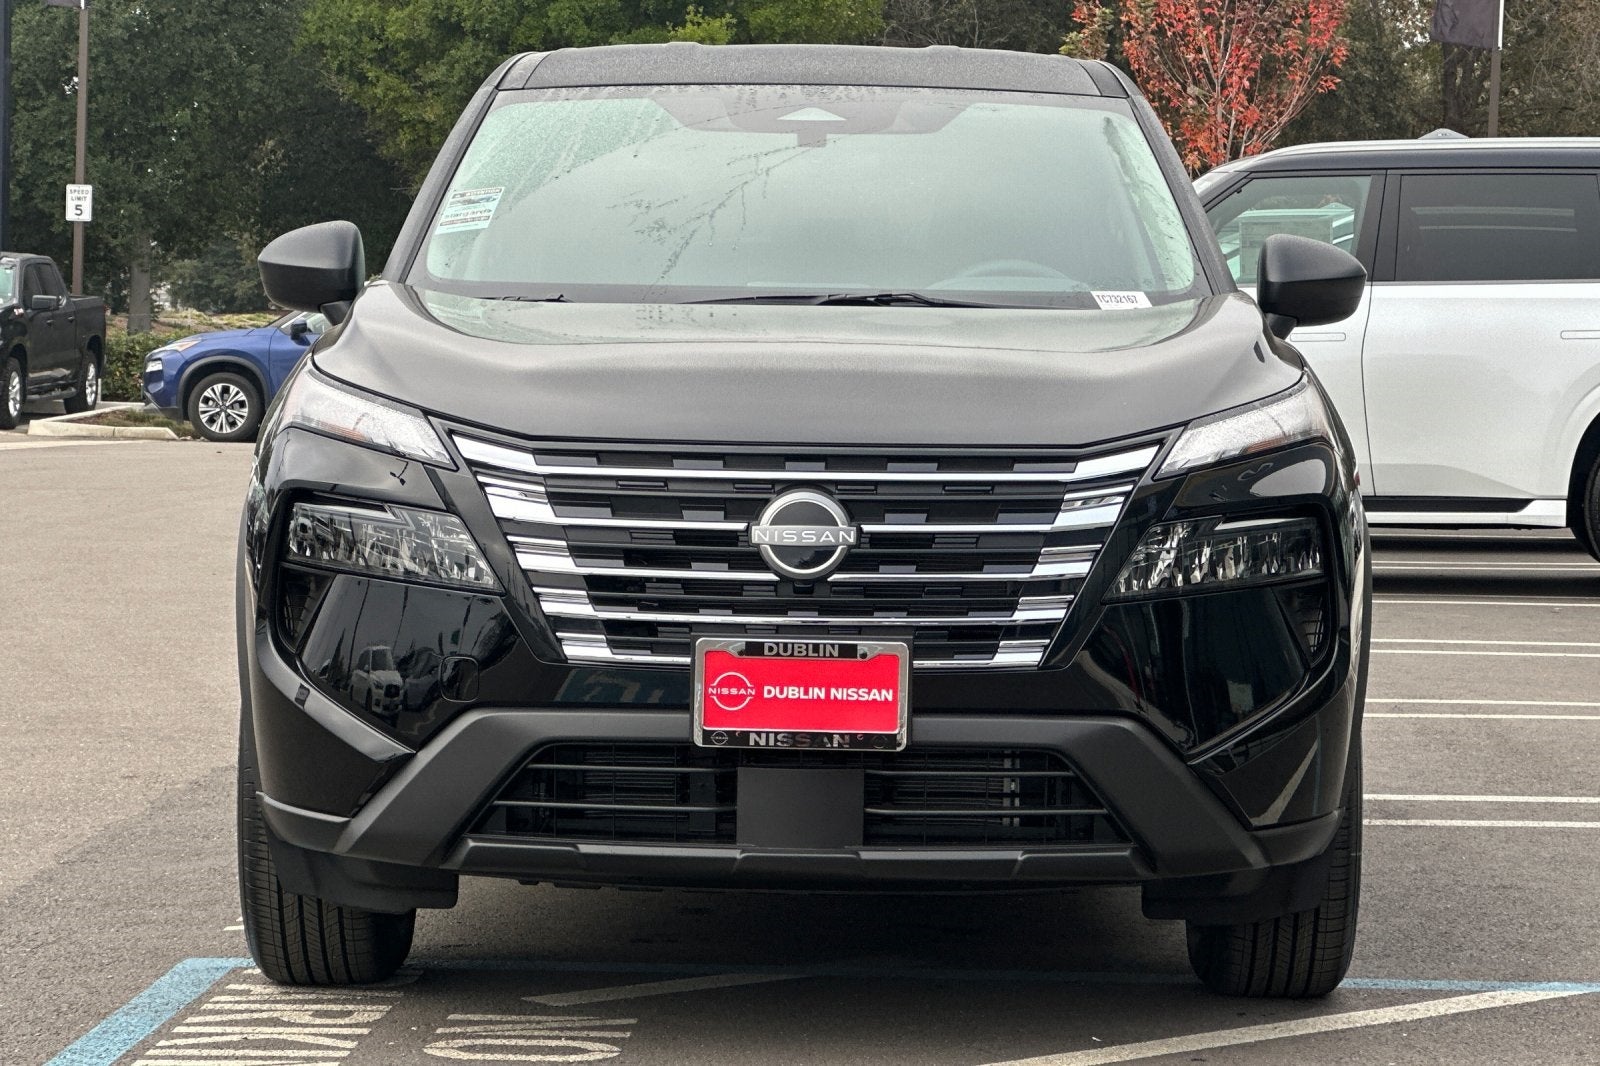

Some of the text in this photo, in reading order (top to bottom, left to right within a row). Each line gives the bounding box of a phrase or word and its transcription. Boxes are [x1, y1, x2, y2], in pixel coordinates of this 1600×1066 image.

[74, 204, 84, 217] 5
[1095, 294, 1138, 304] TC732167
[754, 529, 855, 543] NISSAN
[763, 642, 839, 658] DUBLIN
[708, 687, 756, 696] NISSAN
[763, 685, 893, 702] DUBLIN NISSAN
[749, 731, 850, 749] NISSAN
